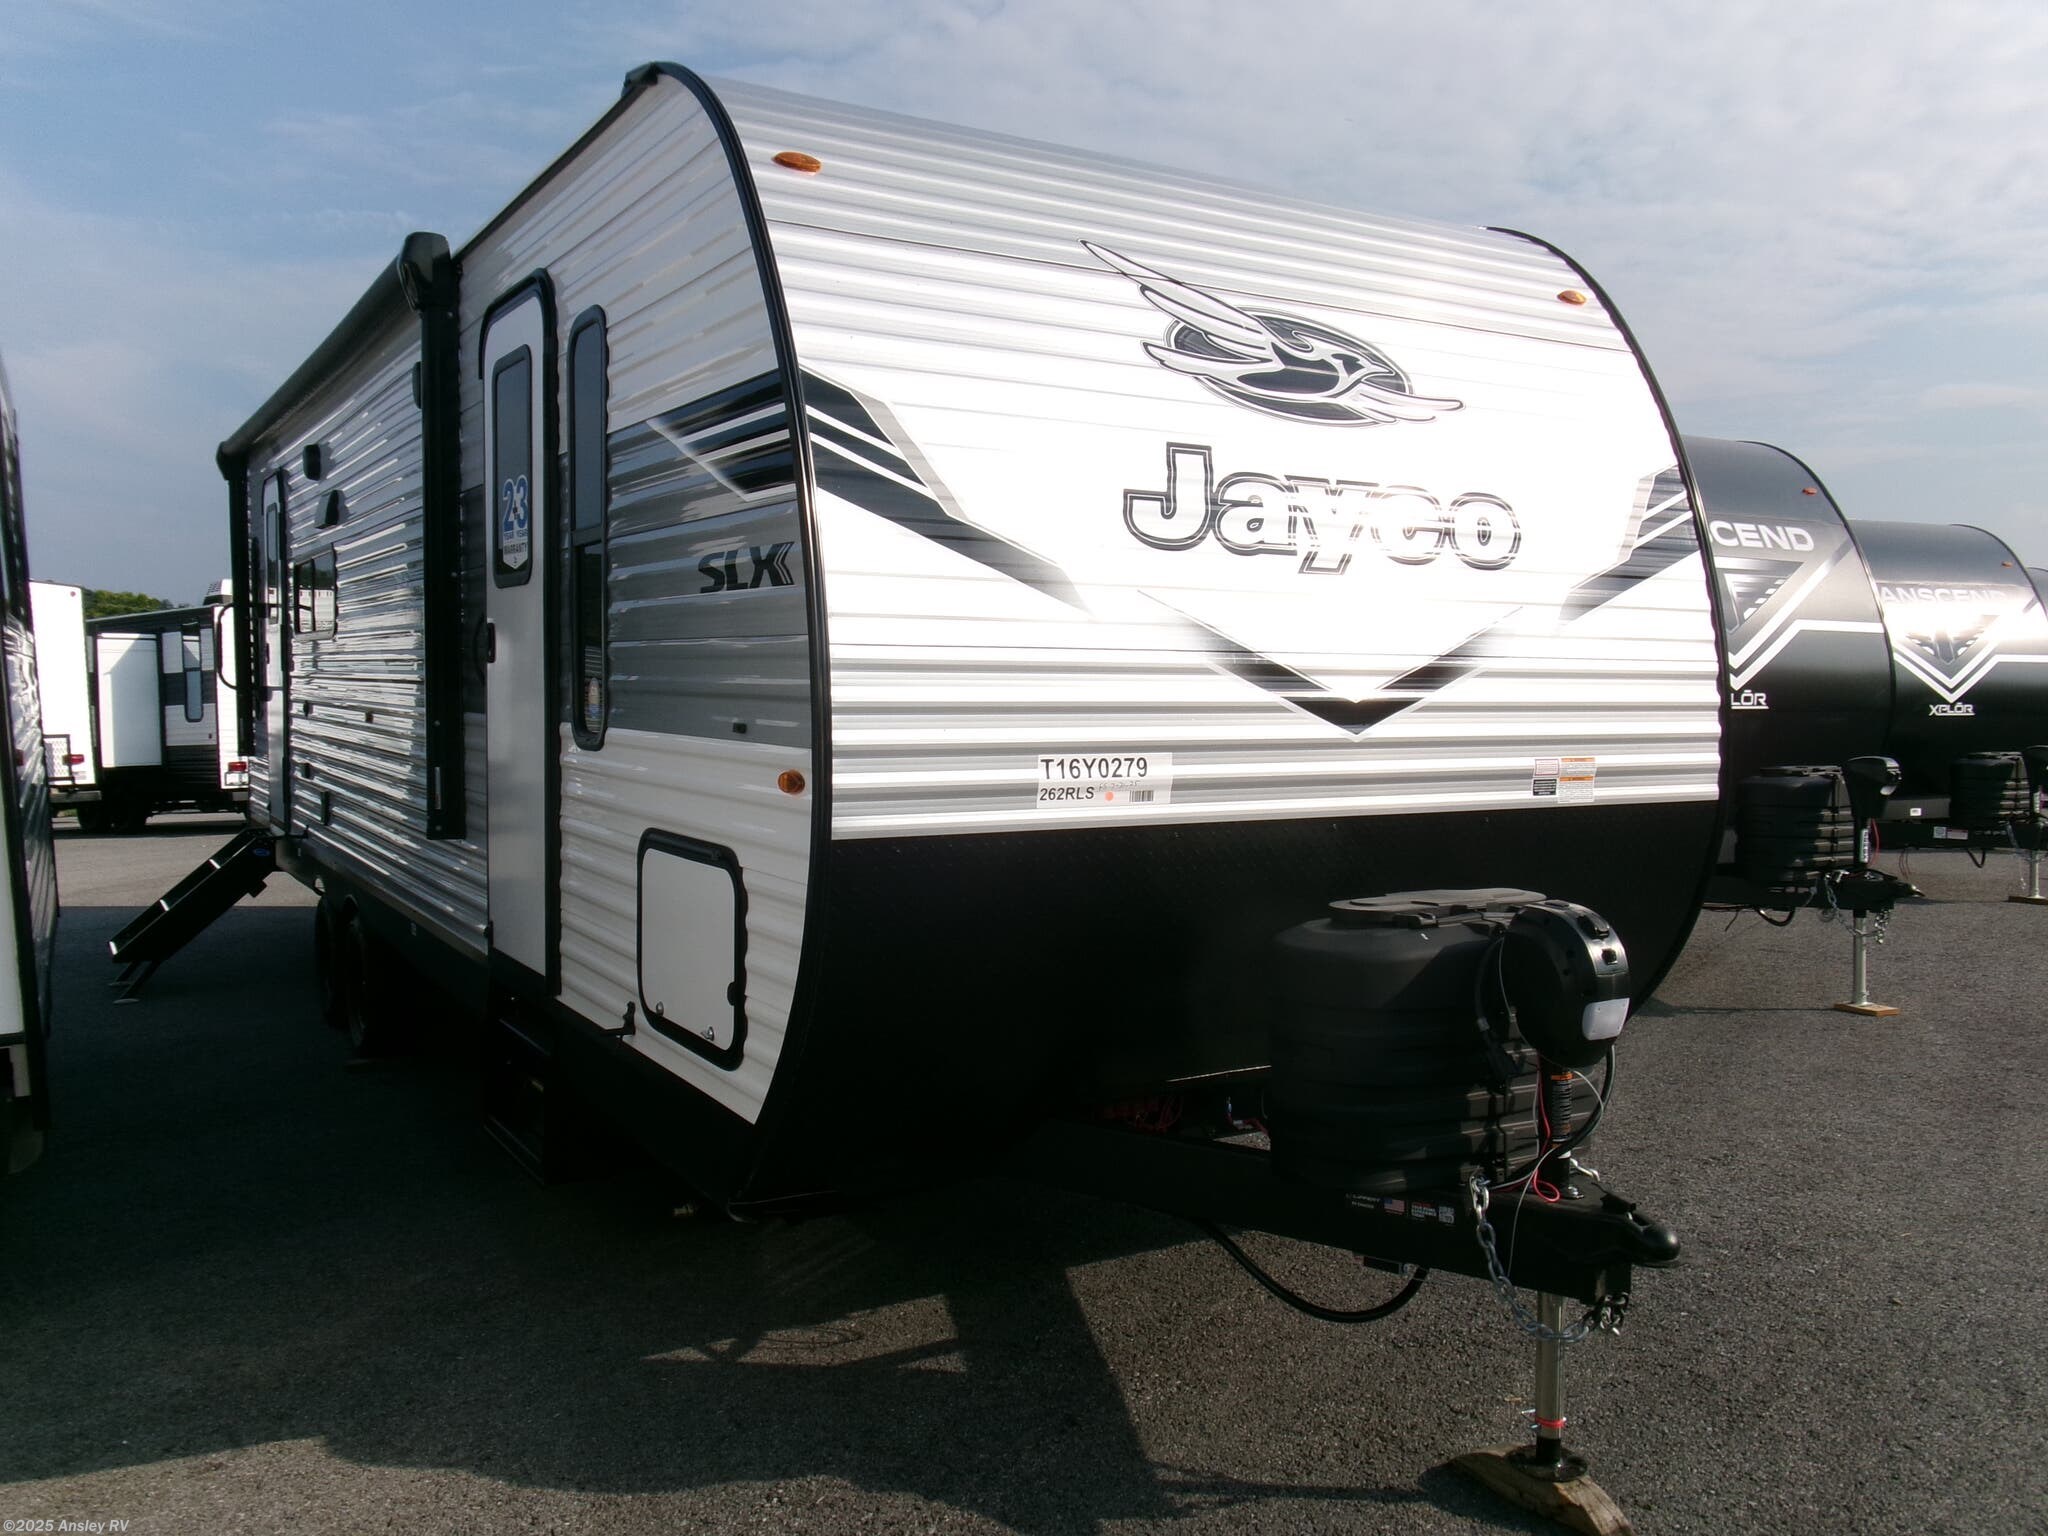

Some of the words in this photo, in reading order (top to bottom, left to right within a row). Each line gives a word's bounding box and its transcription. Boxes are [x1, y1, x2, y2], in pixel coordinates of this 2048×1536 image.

[1123, 441, 1521, 575] Jayco
[1708, 520, 1815, 551] CEND
[698, 541, 795, 593] SLK
[1040, 757, 1148, 779] T16Y0279
[1040, 786, 1095, 801] 262RLS
